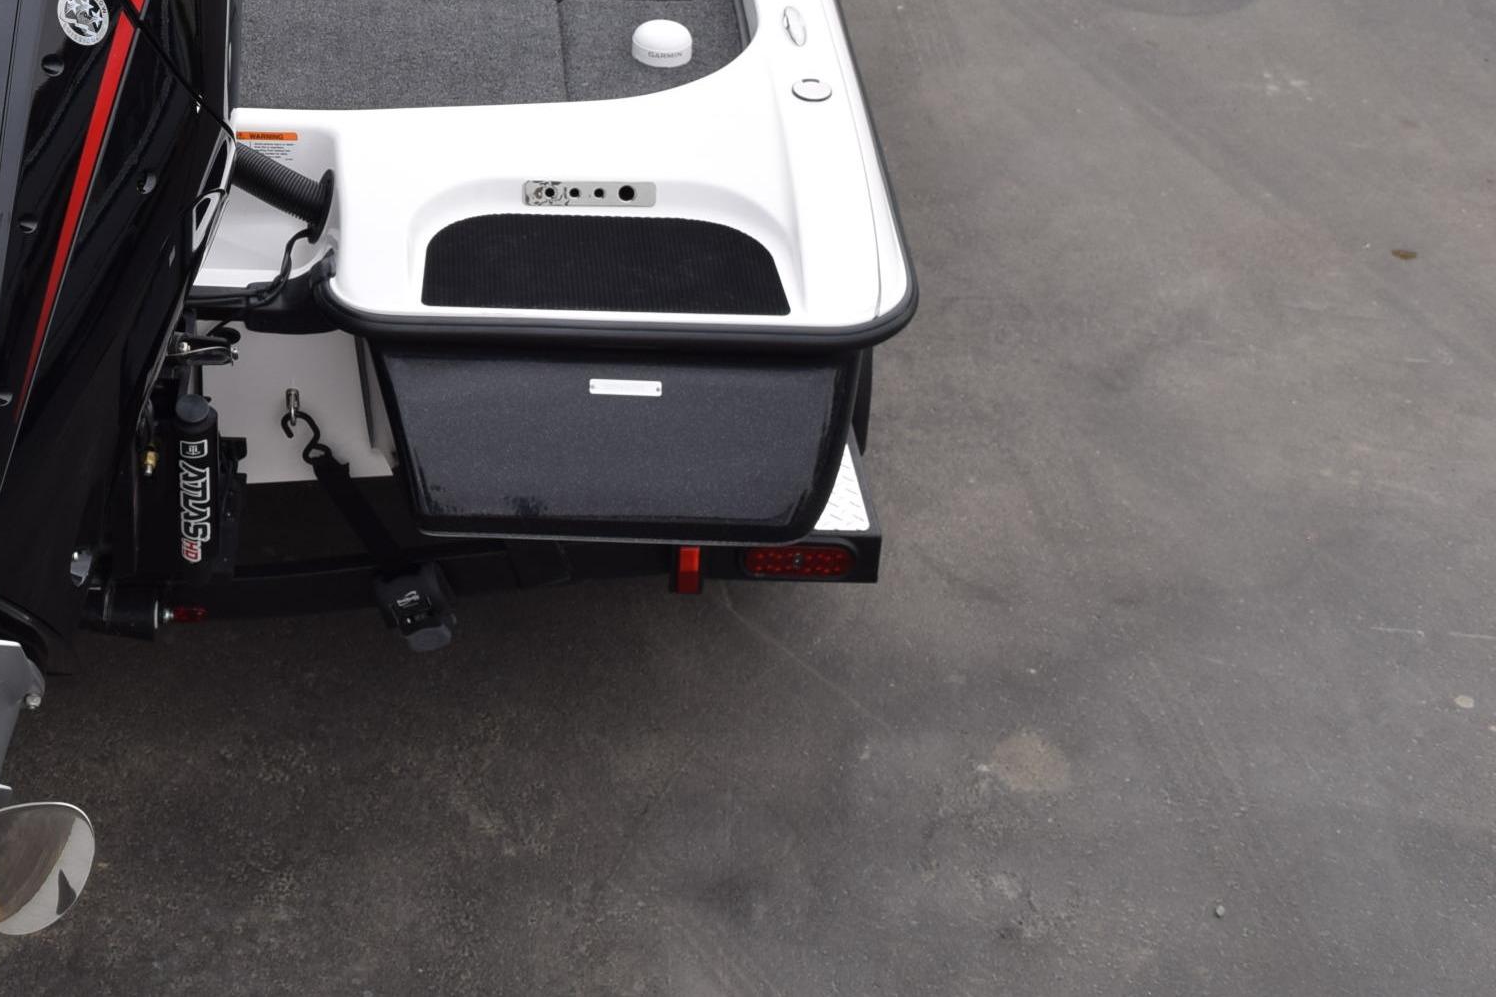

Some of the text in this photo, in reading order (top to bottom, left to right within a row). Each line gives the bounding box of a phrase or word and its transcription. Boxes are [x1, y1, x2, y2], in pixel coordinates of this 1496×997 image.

[648, 50, 683, 59] GARMIN
[248, 132, 285, 140] WARNING
[179, 460, 211, 543] ATLAS
[182, 539, 202, 562] HD
